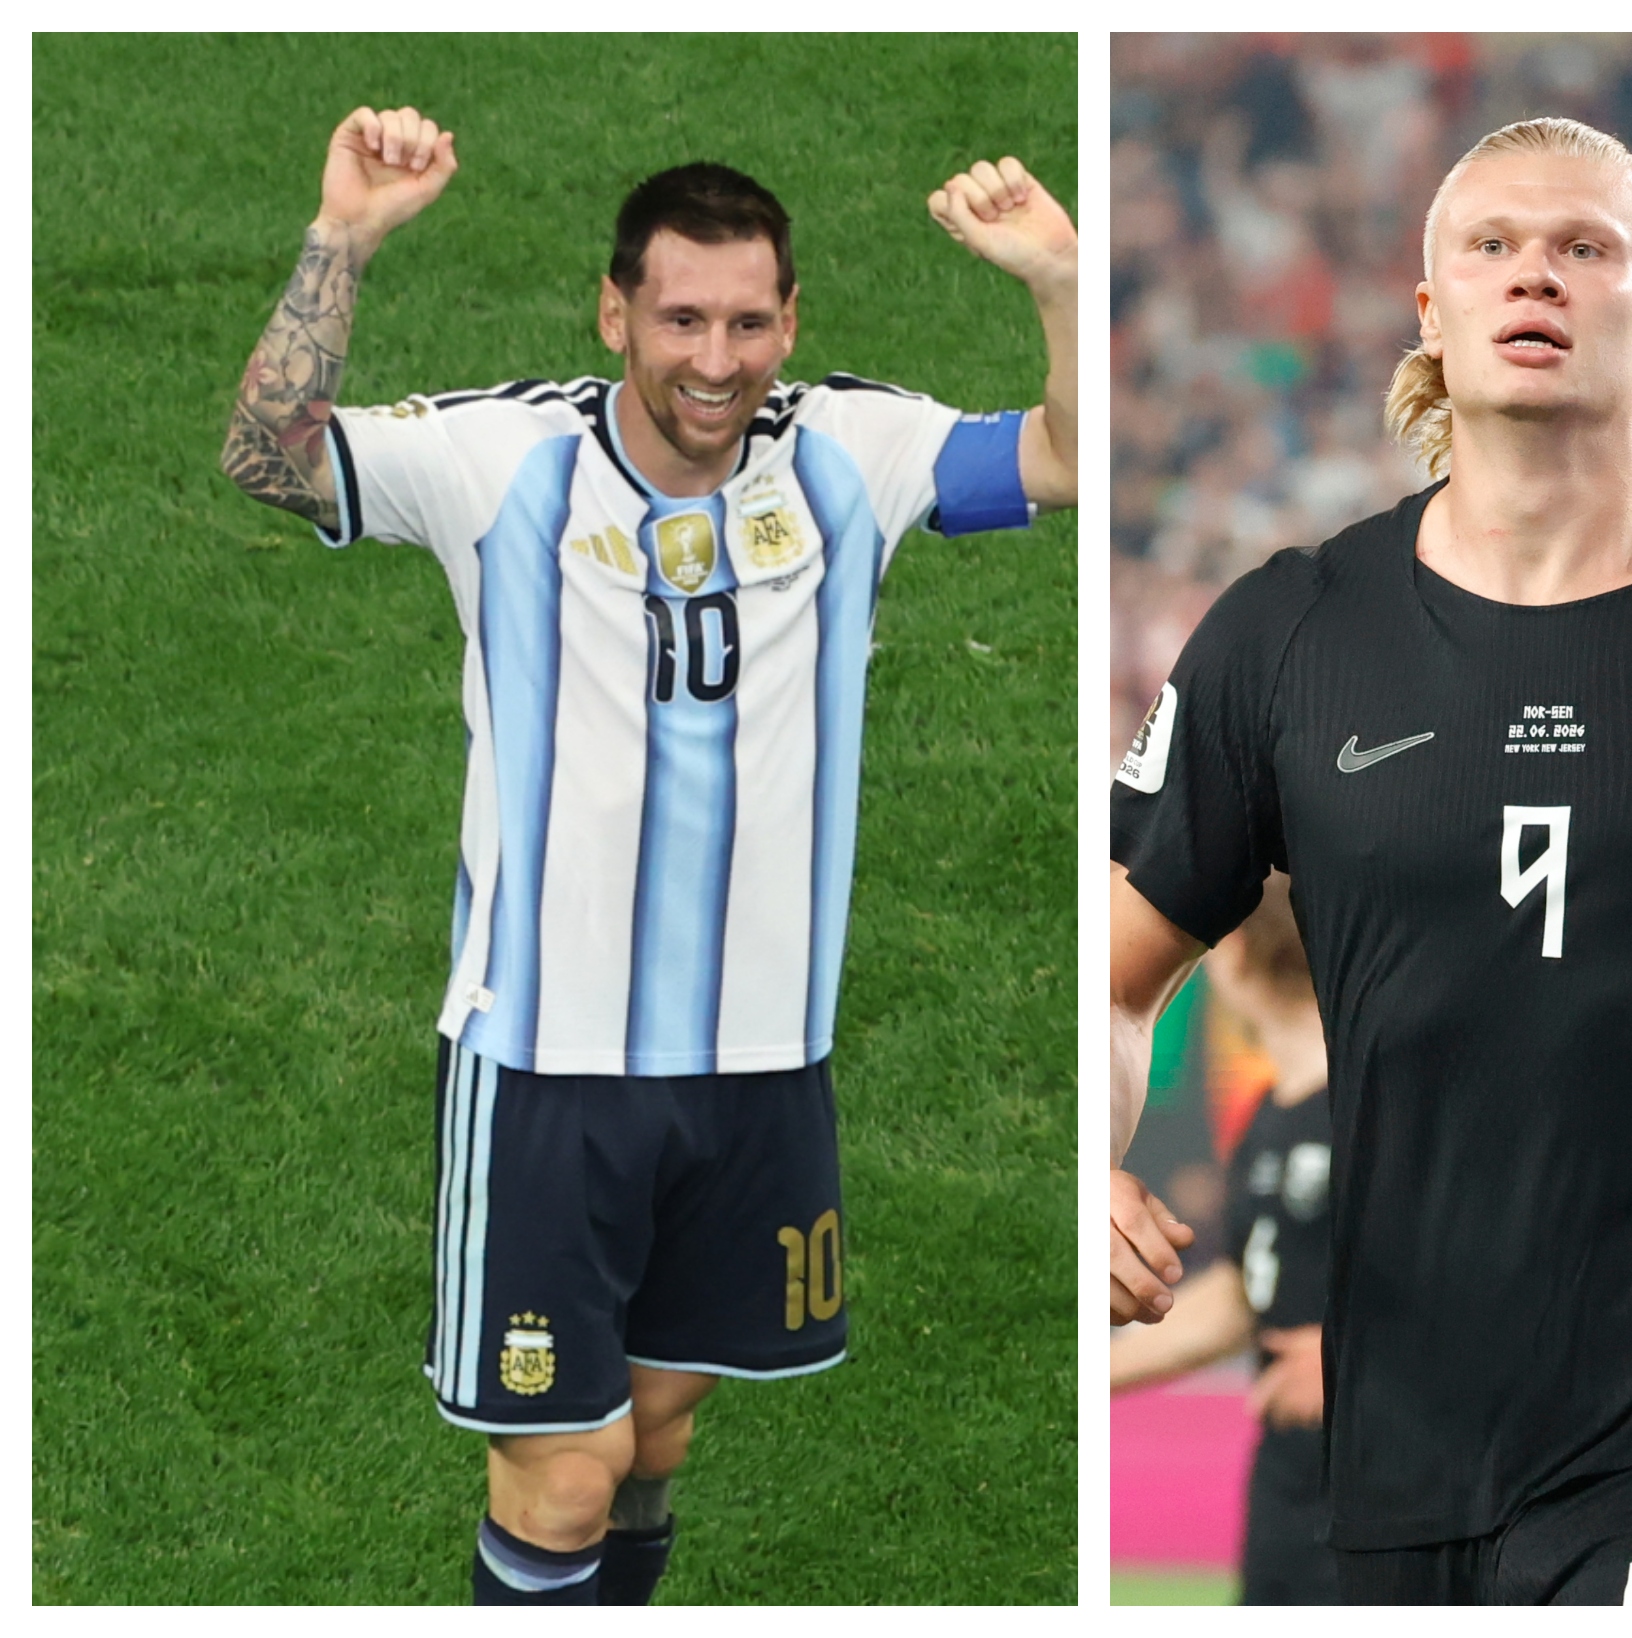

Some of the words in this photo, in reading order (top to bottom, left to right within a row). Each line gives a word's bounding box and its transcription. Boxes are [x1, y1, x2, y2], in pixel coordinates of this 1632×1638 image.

[644, 594, 740, 703] 10
[1523, 705, 1573, 719] NOR-SEN
[1120, 761, 1140, 779] 026
[1504, 744, 1521, 753] NEW
[1522, 743, 1540, 753] YORK
[1541, 743, 1557, 753] NEW
[1558, 743, 1586, 753] JERSEY
[1500, 805, 1571, 958] 9
[777, 1208, 843, 1331] 10
